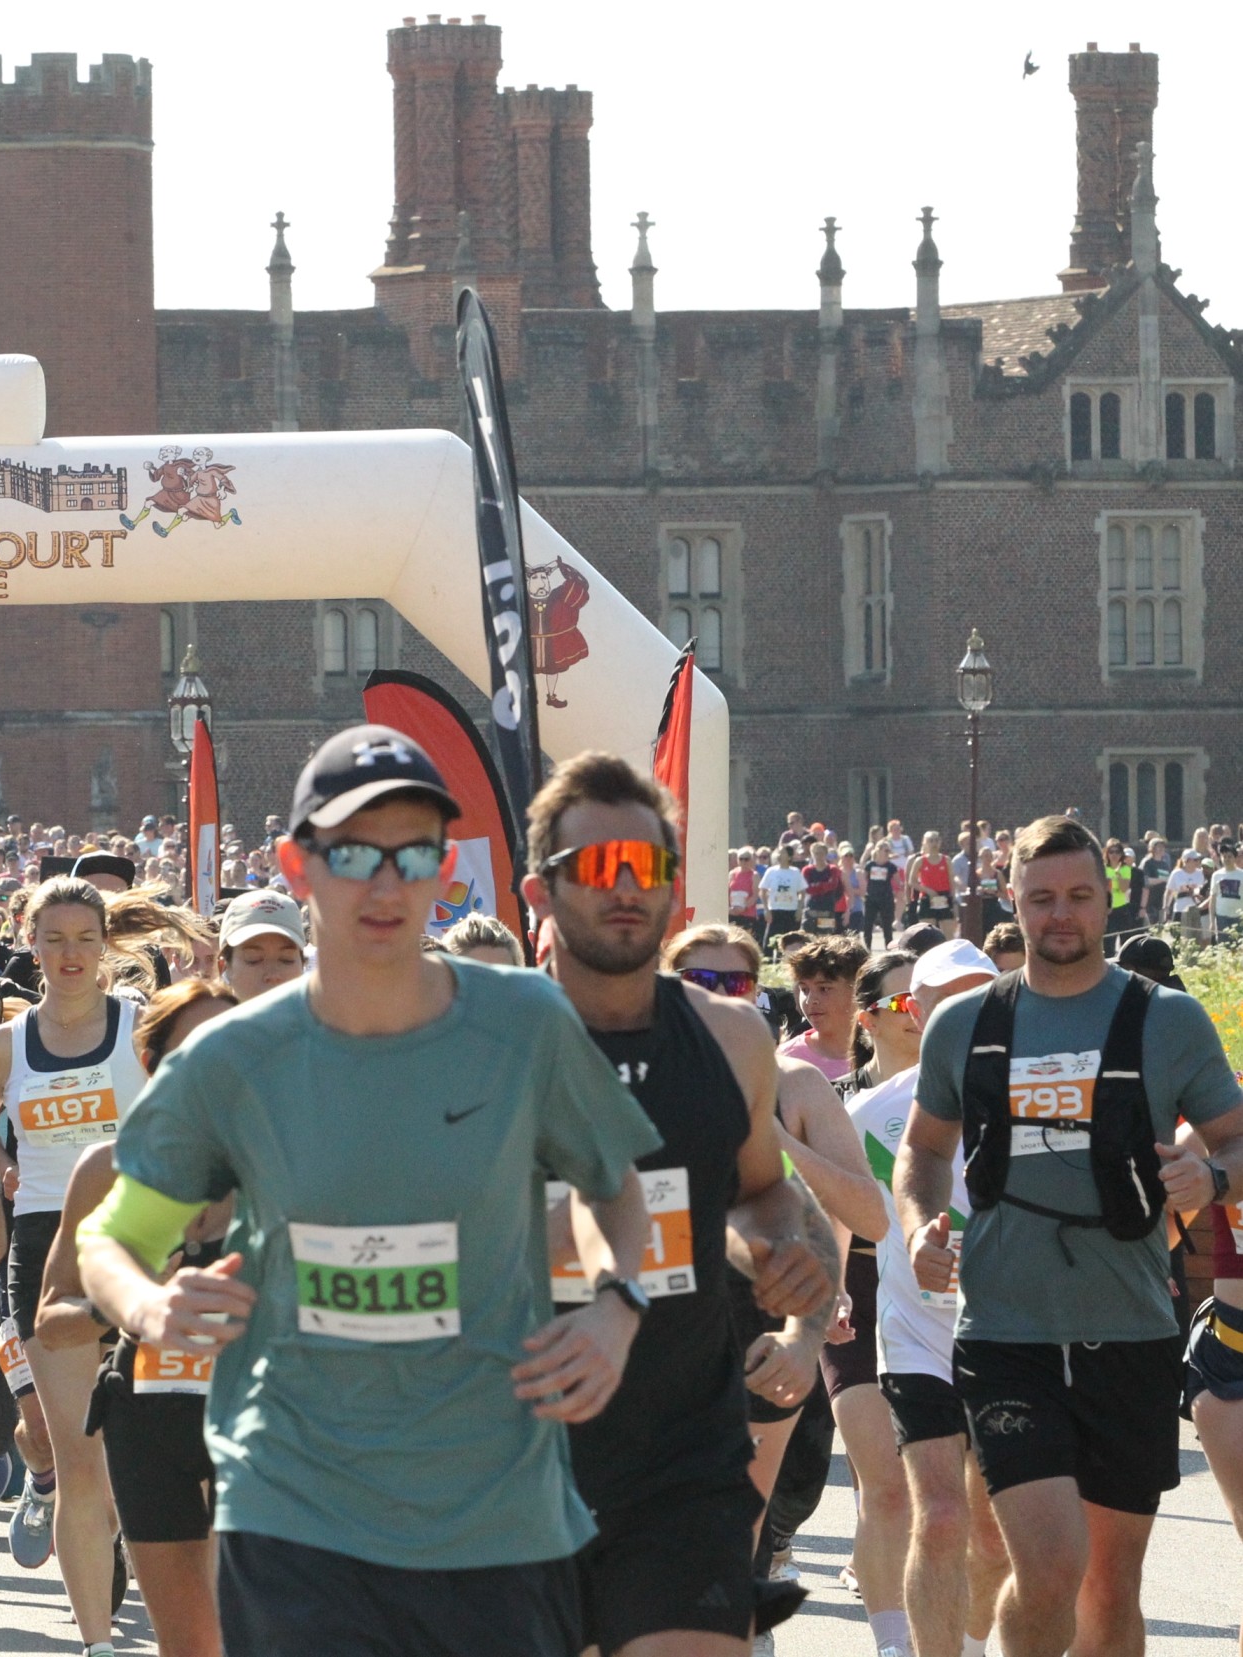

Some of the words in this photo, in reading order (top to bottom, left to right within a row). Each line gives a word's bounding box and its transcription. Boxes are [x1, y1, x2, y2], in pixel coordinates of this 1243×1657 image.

[32, 1094, 101, 1127] 1197
[1009, 1085, 1083, 1118] 793
[308, 1268, 447, 1312] 18118
